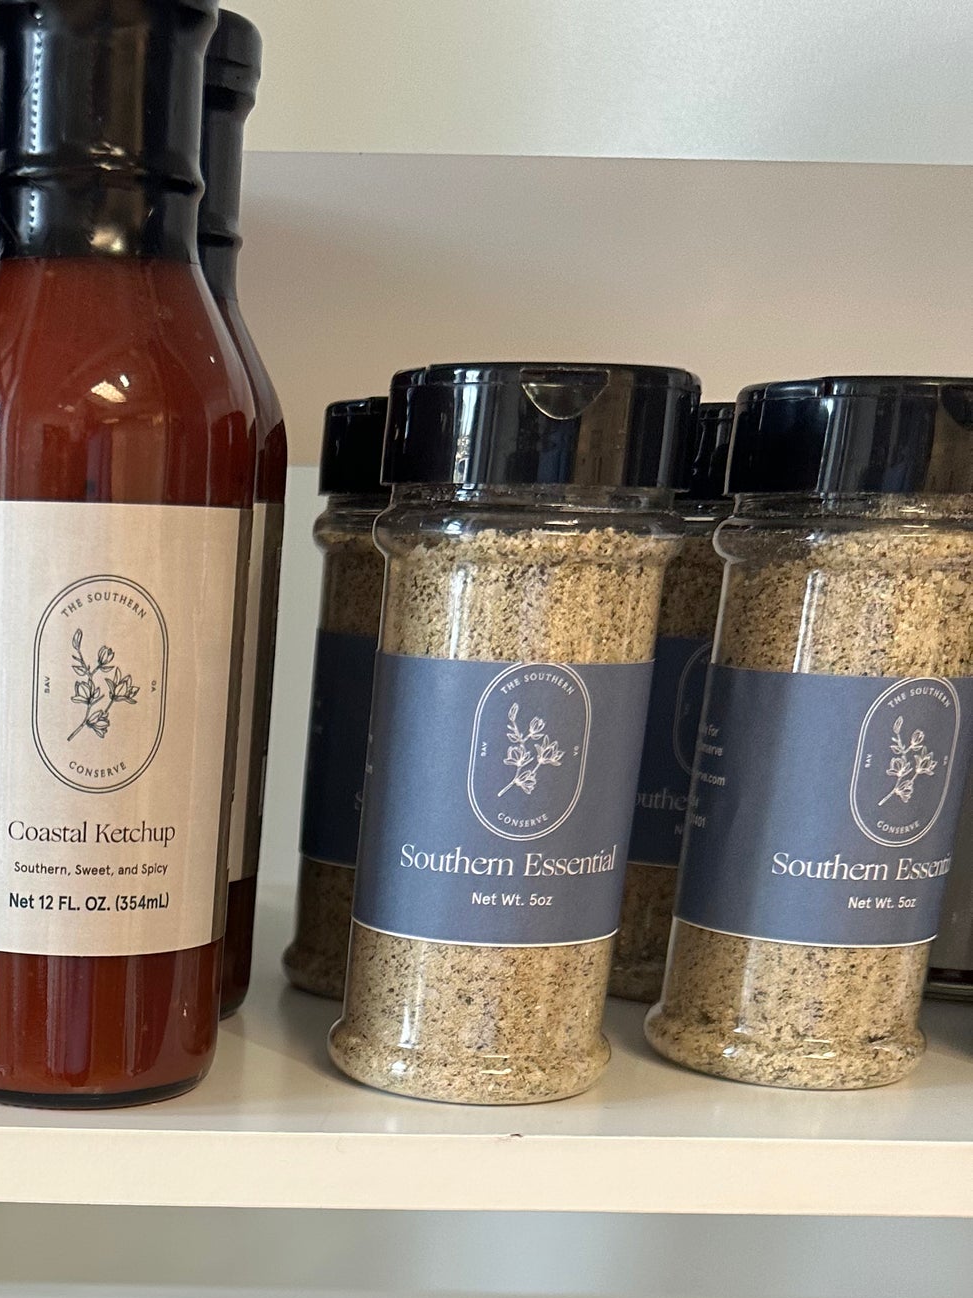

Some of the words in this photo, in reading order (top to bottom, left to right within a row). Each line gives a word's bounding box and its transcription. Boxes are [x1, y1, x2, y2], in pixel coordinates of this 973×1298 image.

[60, 598, 84, 618] THE
[87, 592, 147, 619] SOUTHERN
[500, 678, 521, 694] THE
[523, 673, 575, 695] SOUTHERN
[888, 694, 906, 708] THE
[910, 687, 951, 708] SOUTHERN
[69, 760, 127, 779] CONSERVE
[496, 812, 548, 828] CONSERVE
[876, 820, 920, 834] CONSERVE
[8, 820, 88, 842] Coastal
[95, 822, 175, 847] Ketchup
[14, 861, 71, 877] Southern,
[75, 863, 114, 877] Sweet,
[117, 864, 139, 875] and
[142, 861, 168, 876] Spicy
[400, 844, 513, 876] Southern
[523, 845, 616, 878] Essential
[772, 852, 888, 881] Southern
[895, 853, 952, 881] Essenti
[9, 893, 35, 909] Net
[38, 894, 54, 910] 12
[59, 896, 81, 911] FL.
[85, 896, 111, 912] OZ.
[114, 892, 169, 912] (354mL)
[471, 892, 496, 905] Net
[501, 892, 524, 906] Wt.
[529, 893, 553, 906] 5oz
[848, 896, 871, 908] Net
[875, 896, 894, 909] Wt.
[898, 896, 917, 908] 5oz
